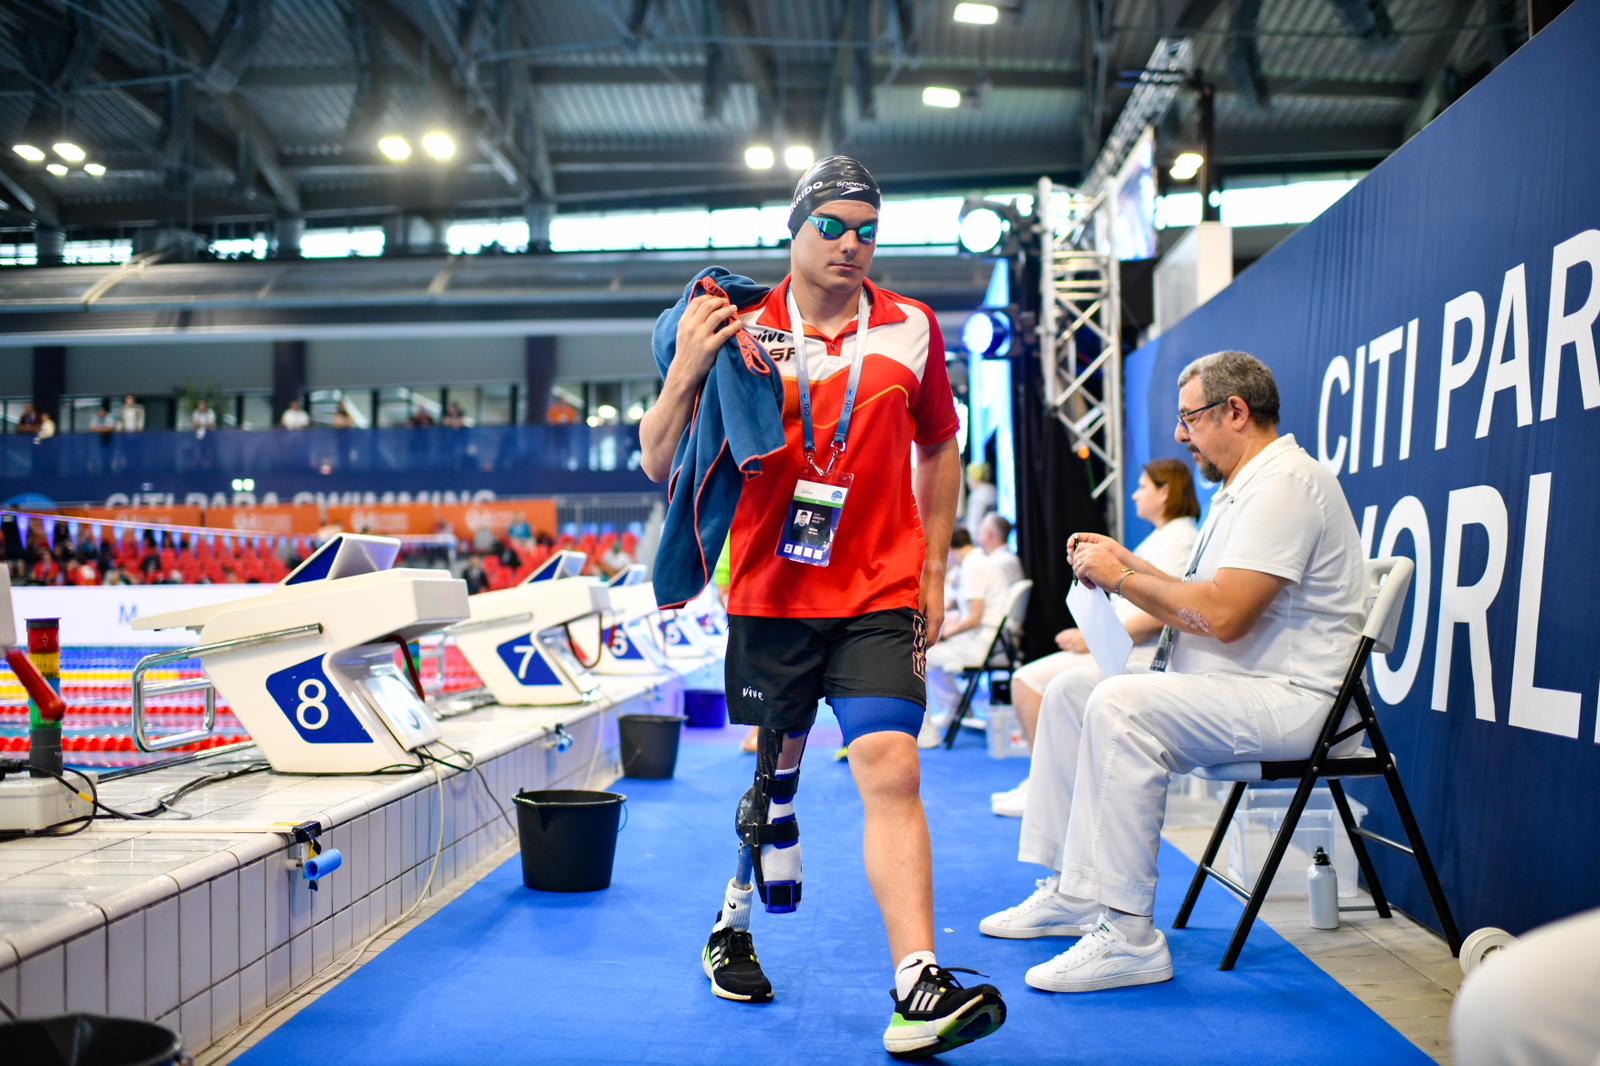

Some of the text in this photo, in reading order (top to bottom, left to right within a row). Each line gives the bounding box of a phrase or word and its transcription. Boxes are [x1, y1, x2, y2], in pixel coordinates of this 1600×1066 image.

[836, 181, 870, 191] speedo
[1318, 229, 1600, 477] CITI PAR
[1362, 472, 1600, 745] ORL
[513, 645, 536, 680] 7
[296, 678, 329, 731] 8
[742, 686, 764, 701] vive
